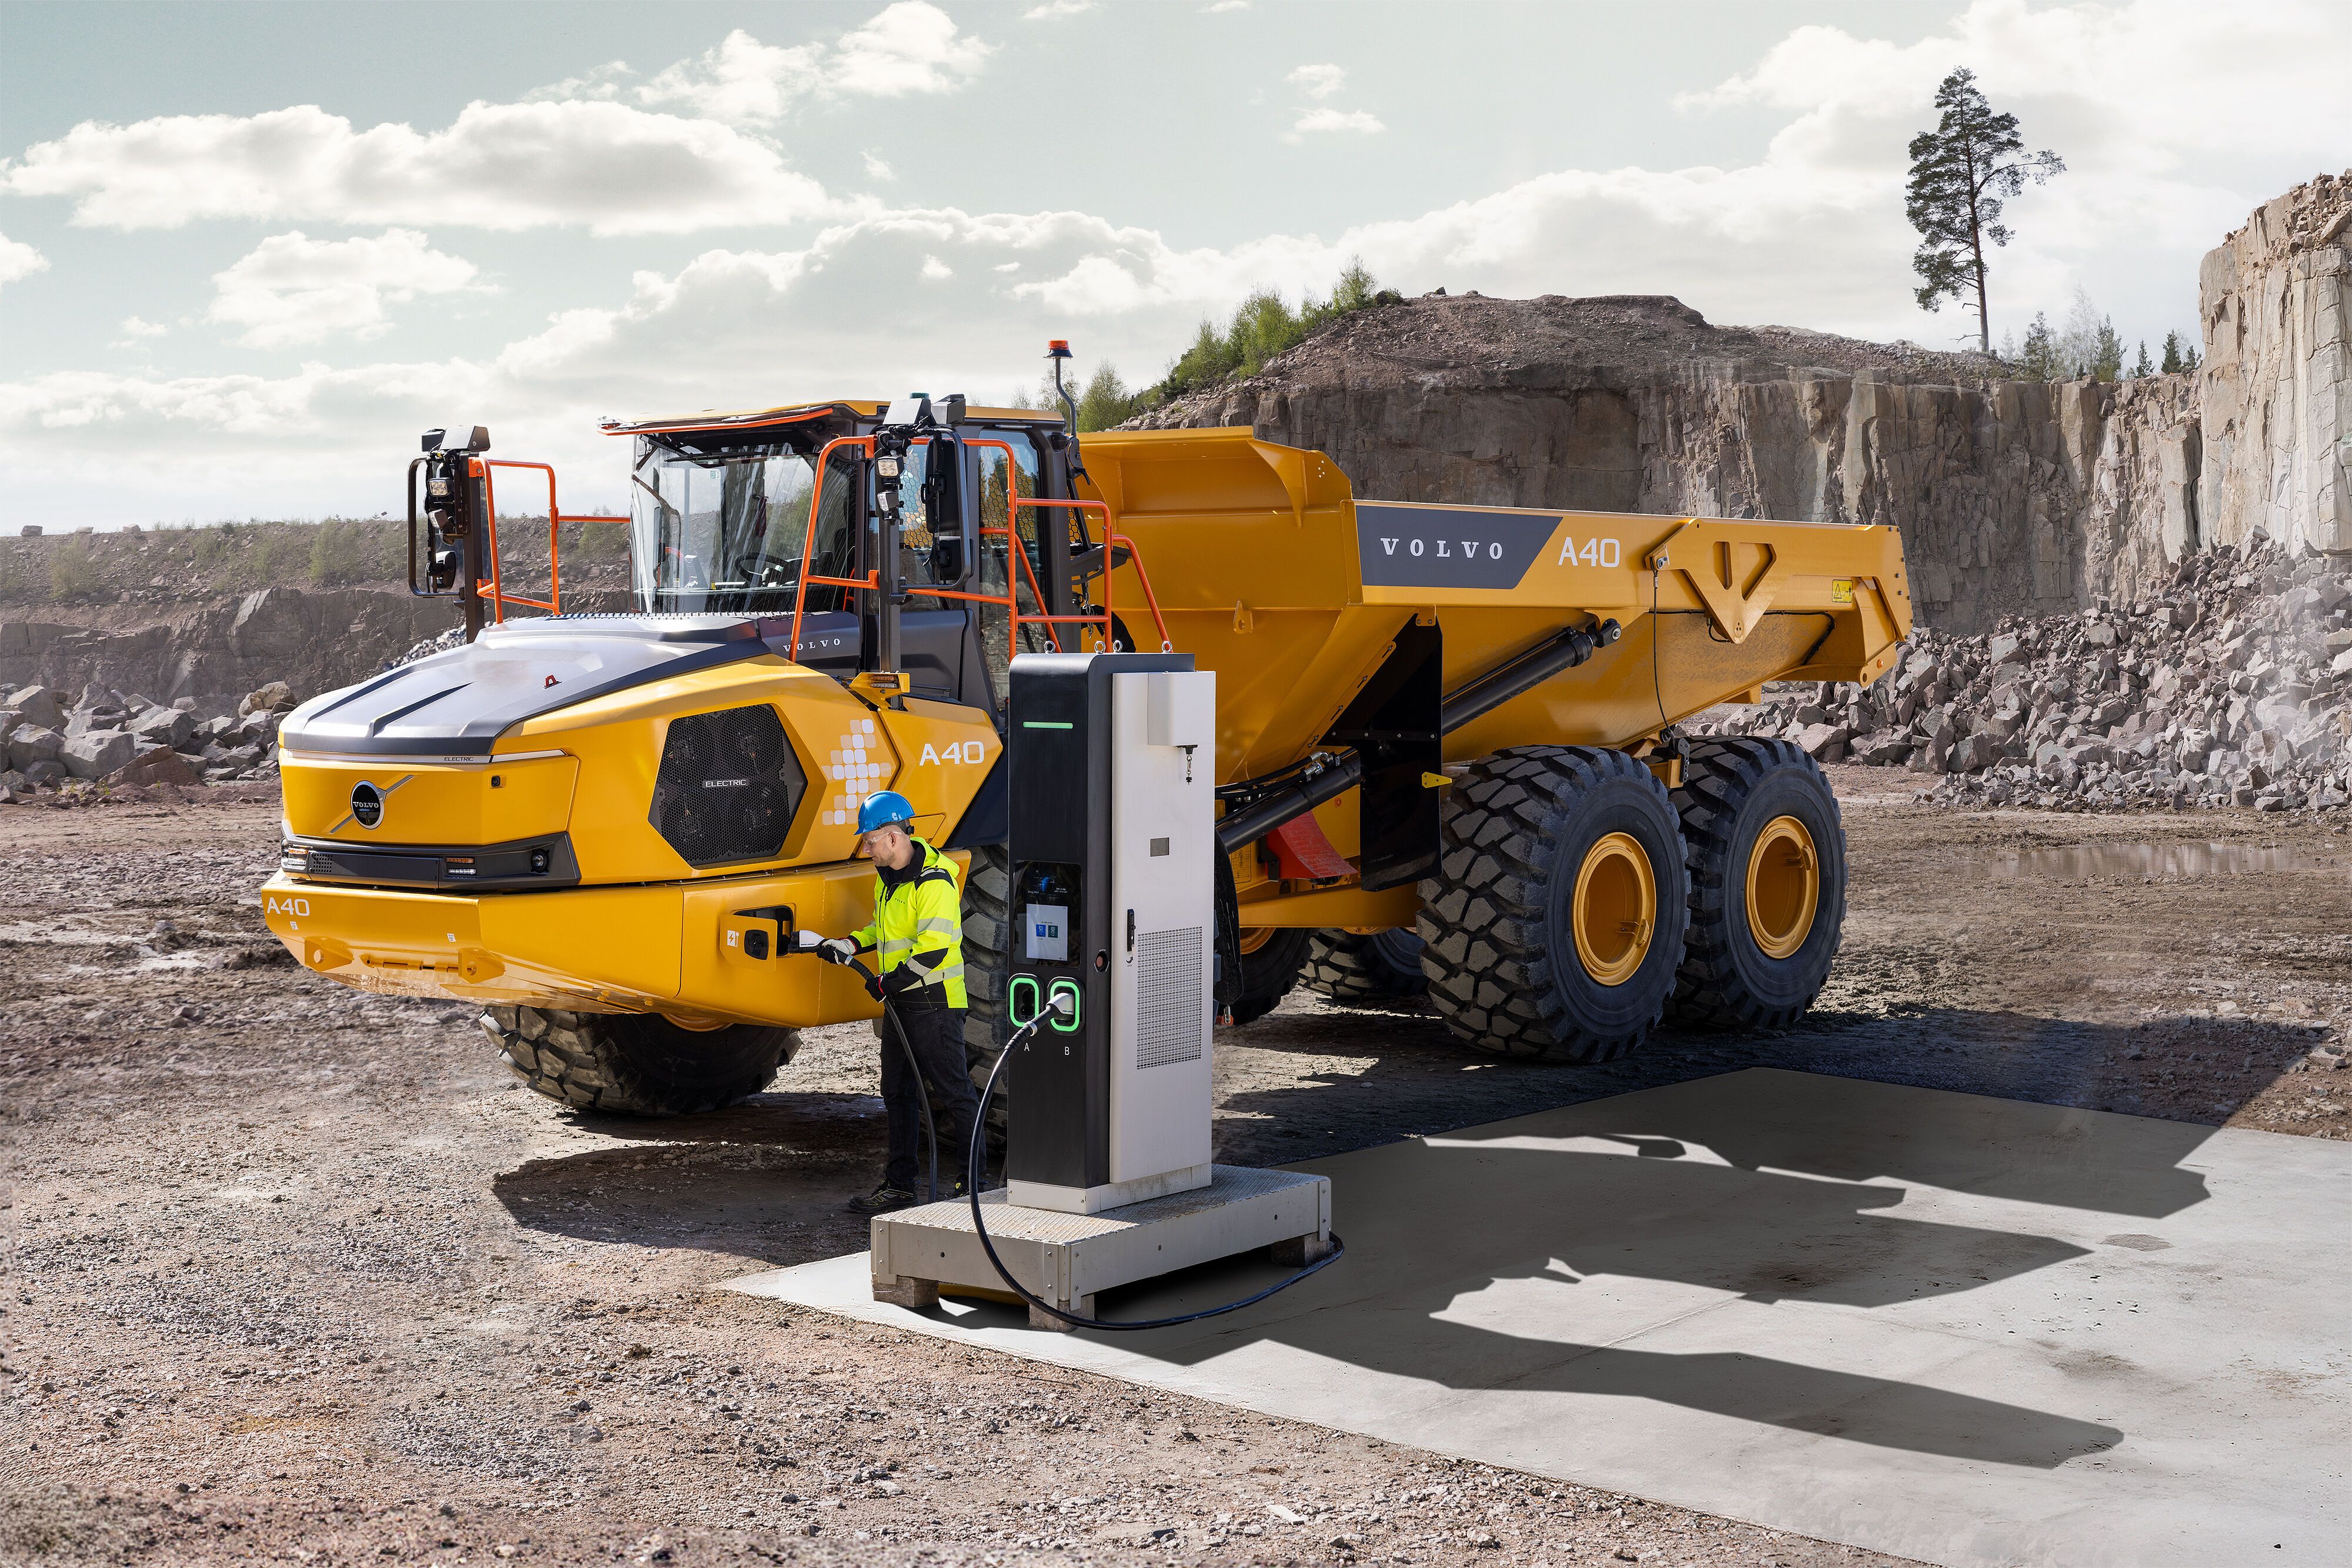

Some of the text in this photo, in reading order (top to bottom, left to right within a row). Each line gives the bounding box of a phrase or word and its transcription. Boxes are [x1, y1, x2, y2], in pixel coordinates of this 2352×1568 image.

[1380, 537, 1503, 560] VOLVO
[1558, 536, 1620, 568] A40
[783, 638, 841, 653] VOLVO
[919, 741, 984, 766] A40
[706, 779, 747, 787] ELECTRIC
[267, 897, 310, 917] A40
[1024, 1042, 1030, 1052] A
[1064, 1047, 1070, 1055] B
